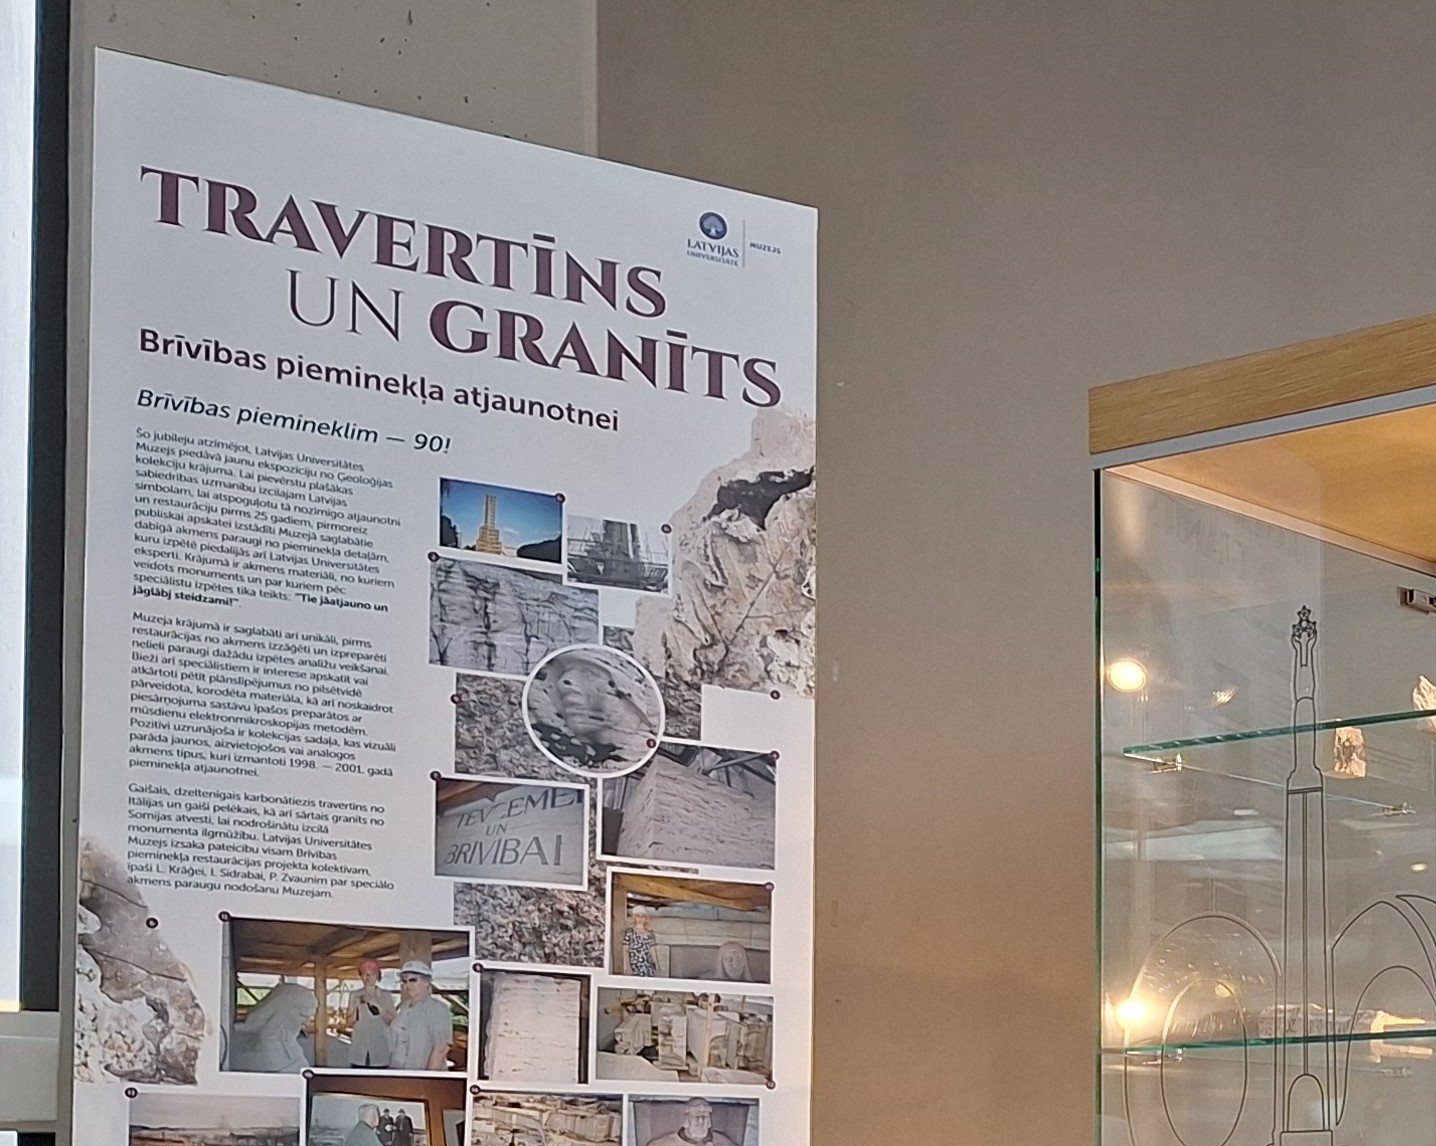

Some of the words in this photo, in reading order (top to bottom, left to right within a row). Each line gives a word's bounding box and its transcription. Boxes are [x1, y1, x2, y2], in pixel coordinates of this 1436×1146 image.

[140, 166, 666, 317] TRAVERTĪNS
[687, 238, 739, 258] LATVIJAS
[749, 242, 781, 254] MUZEJS
[285, 268, 405, 342] UN
[429, 300, 781, 408] GRANĪTS
[140, 328, 267, 370] Brīvības
[277, 355, 444, 405] pieminekļa
[454, 386, 618, 431] atjaunotnei
[137, 389, 230, 418] Brīvības
[237, 406, 378, 443] piemineklim
[414, 433, 451, 453] 90!
[135, 441, 176, 457] Muzejs
[224, 453, 254, 468] jaunu
[319, 470, 334, 480] no
[153, 430, 194, 446] jubileju
[254, 445, 294, 461] Latvijas
[296, 452, 364, 471] Universitātes
[135, 454, 185, 471] kolekciju
[239, 468, 254, 481] Lai
[257, 473, 306, 489] pievērstu
[212, 492, 278, 510] atspoguļotu
[346, 512, 400, 527] atjaunotni
[258, 484, 306, 502] izcilajam
[308, 492, 347, 508] Latvijas
[134, 495, 150, 505] un
[152, 497, 218, 515] restaurāciju
[220, 505, 251, 519] pirms
[316, 520, 367, 536] pirmoreiz
[134, 508, 184, 522] publiskai
[186, 515, 232, 529] apskatei
[278, 526, 317, 542] Muzejā
[319, 534, 373, 549] saglabātie
[134, 532, 160, 545] kuru
[269, 551, 309, 566] Latvijas
[311, 556, 379, 574] Universitātes
[175, 525, 218, 540] akmens
[221, 533, 262, 548] paraugi
[264, 539, 280, 549] no
[282, 541, 341, 557] pieminekļa
[133, 559, 174, 573] veidots
[177, 566, 245, 583] monuments
[247, 575, 262, 585] un
[264, 578, 283, 588] par
[285, 578, 323, 592] kuriem
[326, 584, 346, 596] pēc
[132, 611, 172, 627] Muzeja
[233, 626, 282, 639] saglabāti
[342, 637, 372, 649] pirms
[132, 626, 201, 643] restaurācijas
[204, 635, 220, 645] no
[222, 636, 266, 650] akmens
[313, 647, 328, 657] un
[330, 648, 386, 663] izpreparēti
[132, 639, 164, 651] nelieli
[167, 644, 209, 658] paraugi
[256, 652, 295, 666] izpētes
[130, 665, 177, 679] atkārtoti
[294, 683, 309, 692] no
[130, 705, 186, 719] mūsdienu
[188, 711, 310, 731] elektronmikroskopijas
[209, 700, 250, 712] sastāvu
[291, 708, 349, 722] preparātos
[129, 732, 168, 744] parāda
[214, 738, 286, 754] aizvietojošos
[288, 746, 304, 756] vai
[306, 748, 355, 762] analogos
[129, 758, 190, 773] pieminekļa
[244, 792, 316, 808] karbonātiezis
[127, 824, 198, 837] monumenta
[262, 832, 302, 846] Latvijas
[304, 835, 372, 851] Universitātes
[128, 808, 172, 823] Somijas
[301, 822, 328, 835] izcilā
[127, 835, 168, 849] Muzejs
[170, 838, 204, 850] izsaka
[261, 846, 293, 857] visam
[127, 849, 189, 864] pieminekļa
[192, 855, 261, 869] restaurācijas
[264, 860, 308, 872] projekta
[126, 874, 171, 887] akmens
[174, 879, 220, 892] paraugu
[224, 882, 279, 895] nodošanu
